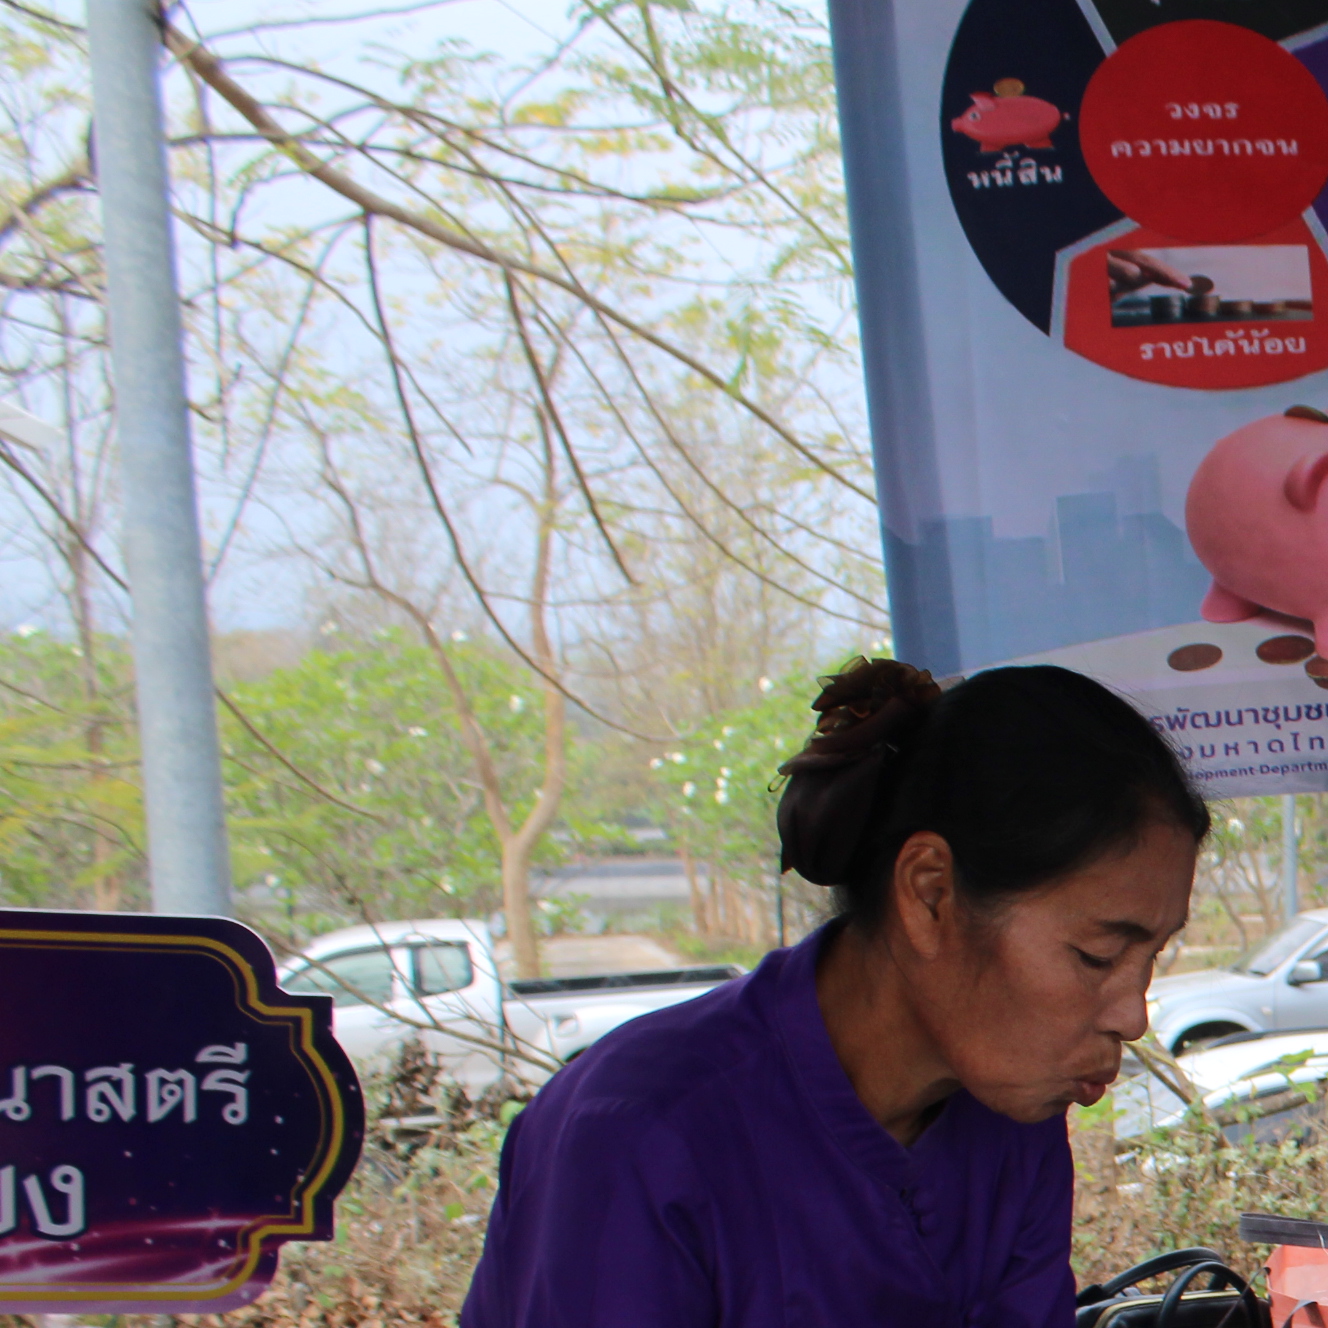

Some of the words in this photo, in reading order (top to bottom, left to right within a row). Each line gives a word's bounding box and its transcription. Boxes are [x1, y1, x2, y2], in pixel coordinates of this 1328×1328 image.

[1165, 102, 1239, 122] วงจร
[1110, 137, 1299, 159] ความยากจน
[967, 151, 1063, 189] หนี้สิน
[1139, 328, 1306, 361] รายได้น้อย
